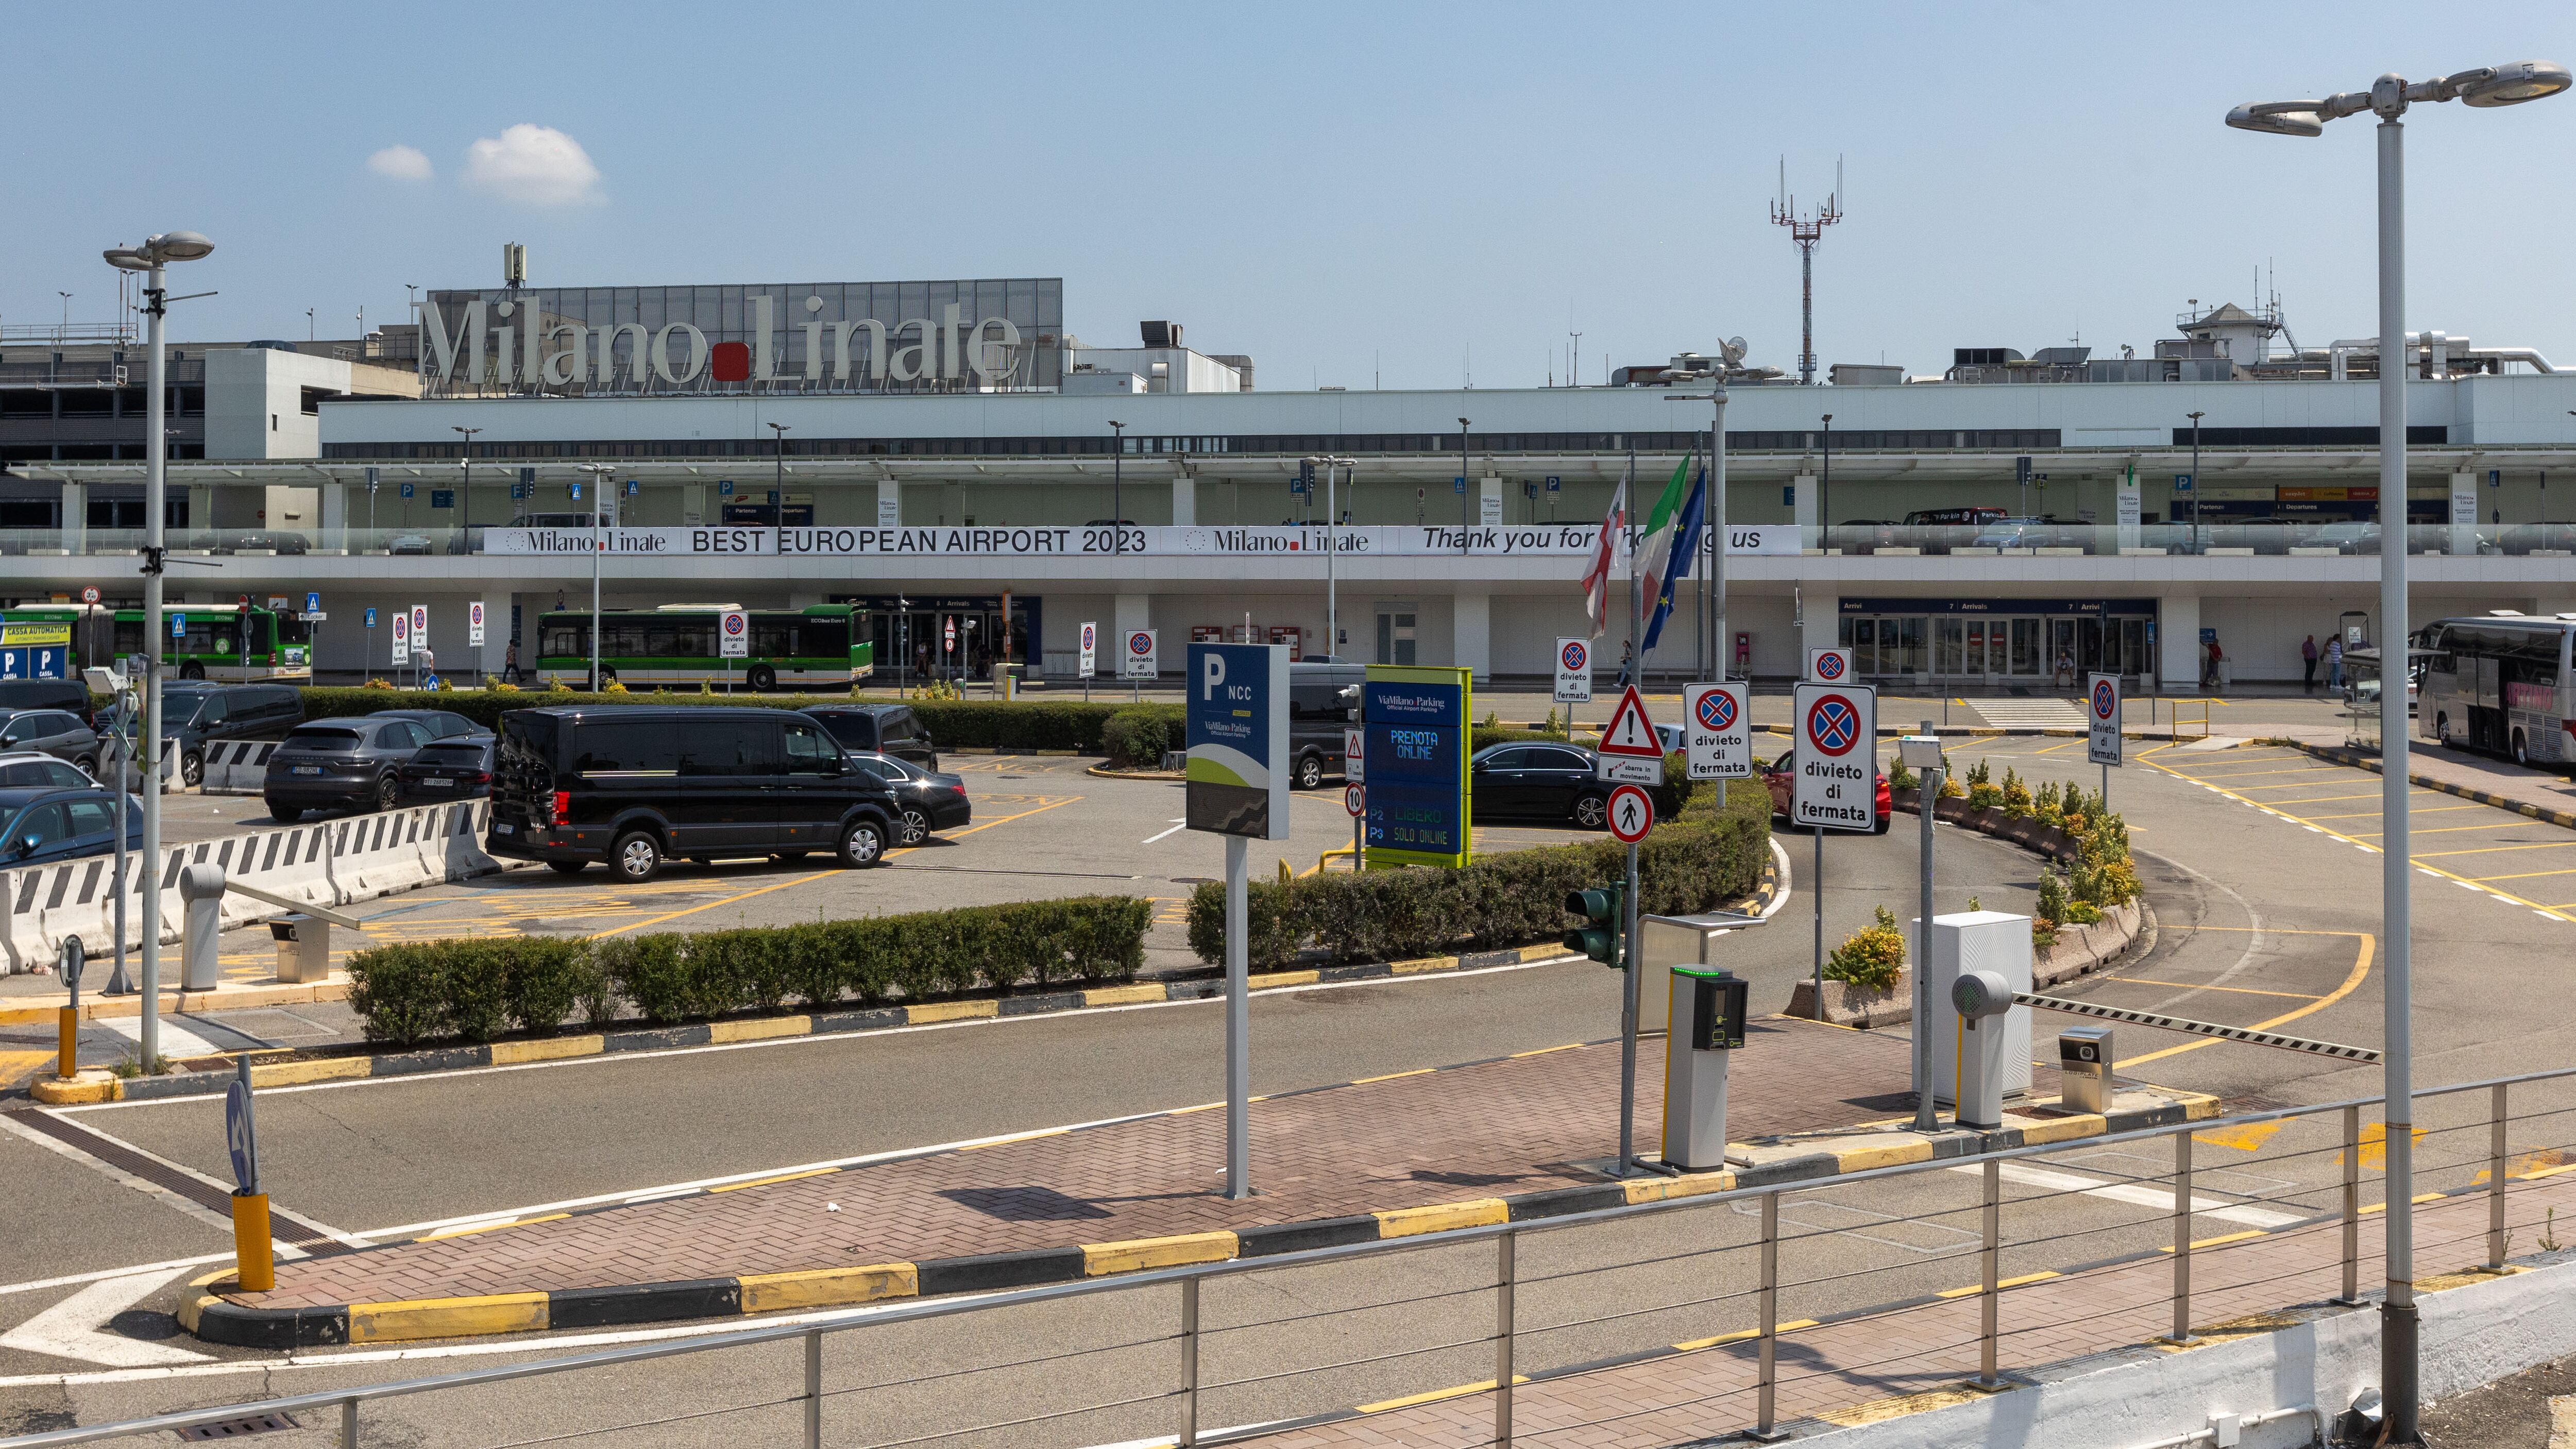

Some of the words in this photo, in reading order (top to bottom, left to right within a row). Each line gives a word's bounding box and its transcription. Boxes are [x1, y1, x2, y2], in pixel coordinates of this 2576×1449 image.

[411, 295, 708, 385] Milano
[747, 294, 1021, 381] Linate
[722, 482, 730, 493] P
[1549, 478, 1557, 490] P
[2179, 477, 2188, 488] P
[403, 485, 411, 496] P
[527, 530, 594, 551] Milano
[606, 531, 666, 551] Linate
[693, 531, 766, 552] BEST
[781, 530, 937, 552] EUROPEAN
[945, 530, 1070, 552] AIRPORT
[1082, 530, 1146, 552] 2023
[1214, 530, 1287, 551] Milano
[1301, 530, 1368, 551] Linate
[1423, 527, 1496, 549] Thank
[1503, 529, 1553, 553] you
[1560, 527, 1595, 548] for
[1731, 532, 1761, 548] us
[29, 627, 67, 635] AUTOMATICA
[5, 652, 14, 672] P
[42, 650, 51, 670] P
[1204, 653, 1226, 701] P
[1228, 685, 1251, 700] NCC
[1561, 673, 1587, 681] divieto
[1378, 695, 1414, 705] ViaMilano
[1417, 697, 1445, 710] Parking
[1558, 691, 1588, 699] fermata
[1205, 721, 1230, 731] ViaMilano
[1231, 723, 1251, 735] Parking
[2093, 722, 2115, 734] divieto
[1391, 730, 1438, 746] PRENOTA
[1696, 735, 1741, 746] divieto
[2101, 737, 2107, 747] di
[1397, 745, 1433, 760] ONLINE
[1713, 750, 1725, 760] di
[2092, 748, 2117, 761] fermata
[1693, 762, 1746, 773] fermata
[1805, 761, 1862, 780] divieto
[1350, 791, 1360, 807] 10
[1825, 784, 1840, 799] di
[1370, 806, 1383, 820] P2
[1395, 806, 1441, 823] LIBERO
[1801, 801, 1866, 821] fermata
[1370, 827, 1384, 839] P3
[1394, 827, 1414, 841] SOLO
[1420, 830, 1447, 845] ONLINE
